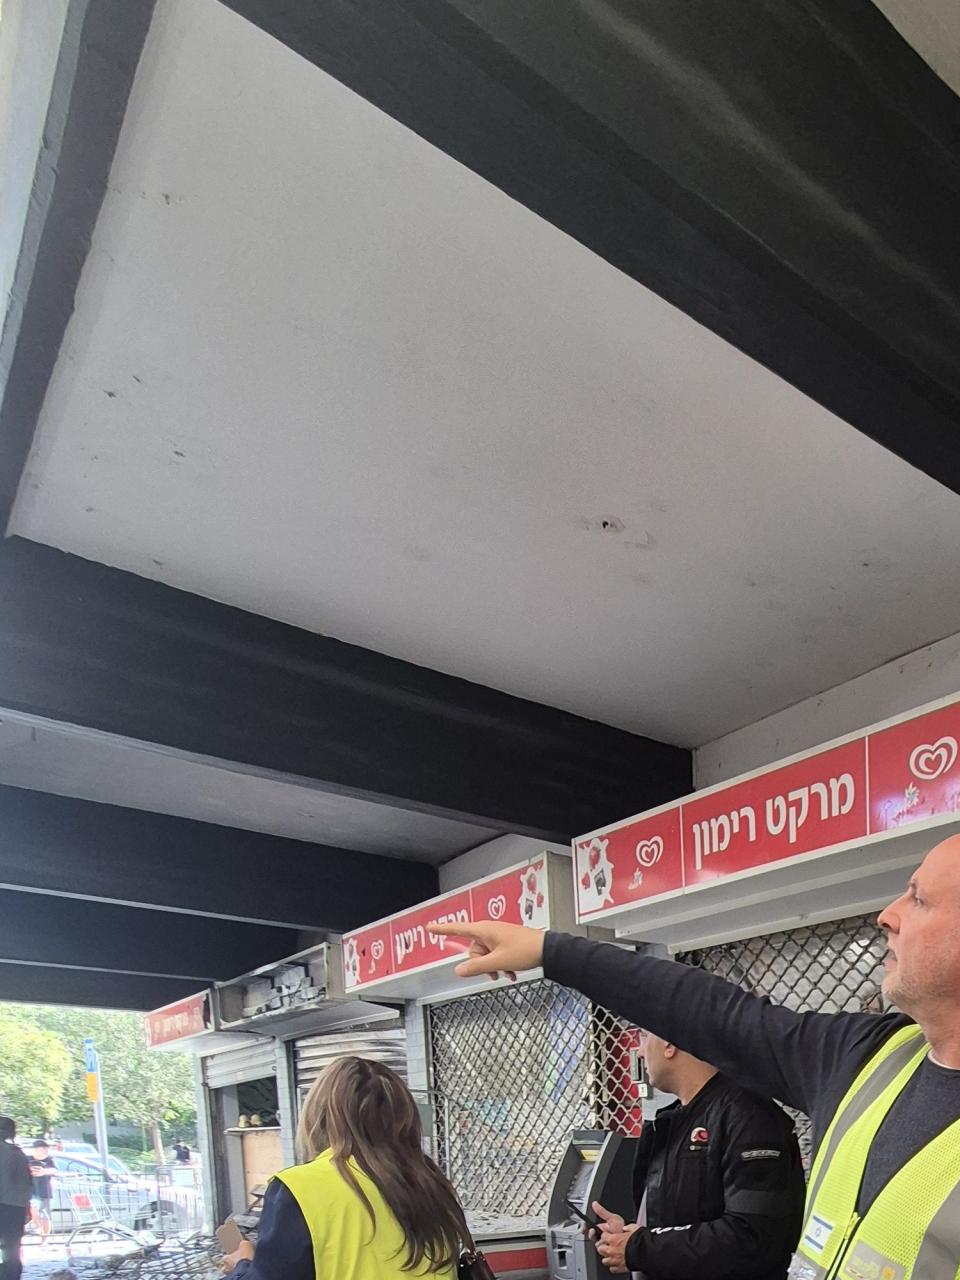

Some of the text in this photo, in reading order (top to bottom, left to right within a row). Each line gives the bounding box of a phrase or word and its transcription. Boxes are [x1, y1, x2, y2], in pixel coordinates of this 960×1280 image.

[692, 773, 855, 871] מרקט רימון
[395, 925, 426, 965] רימון
